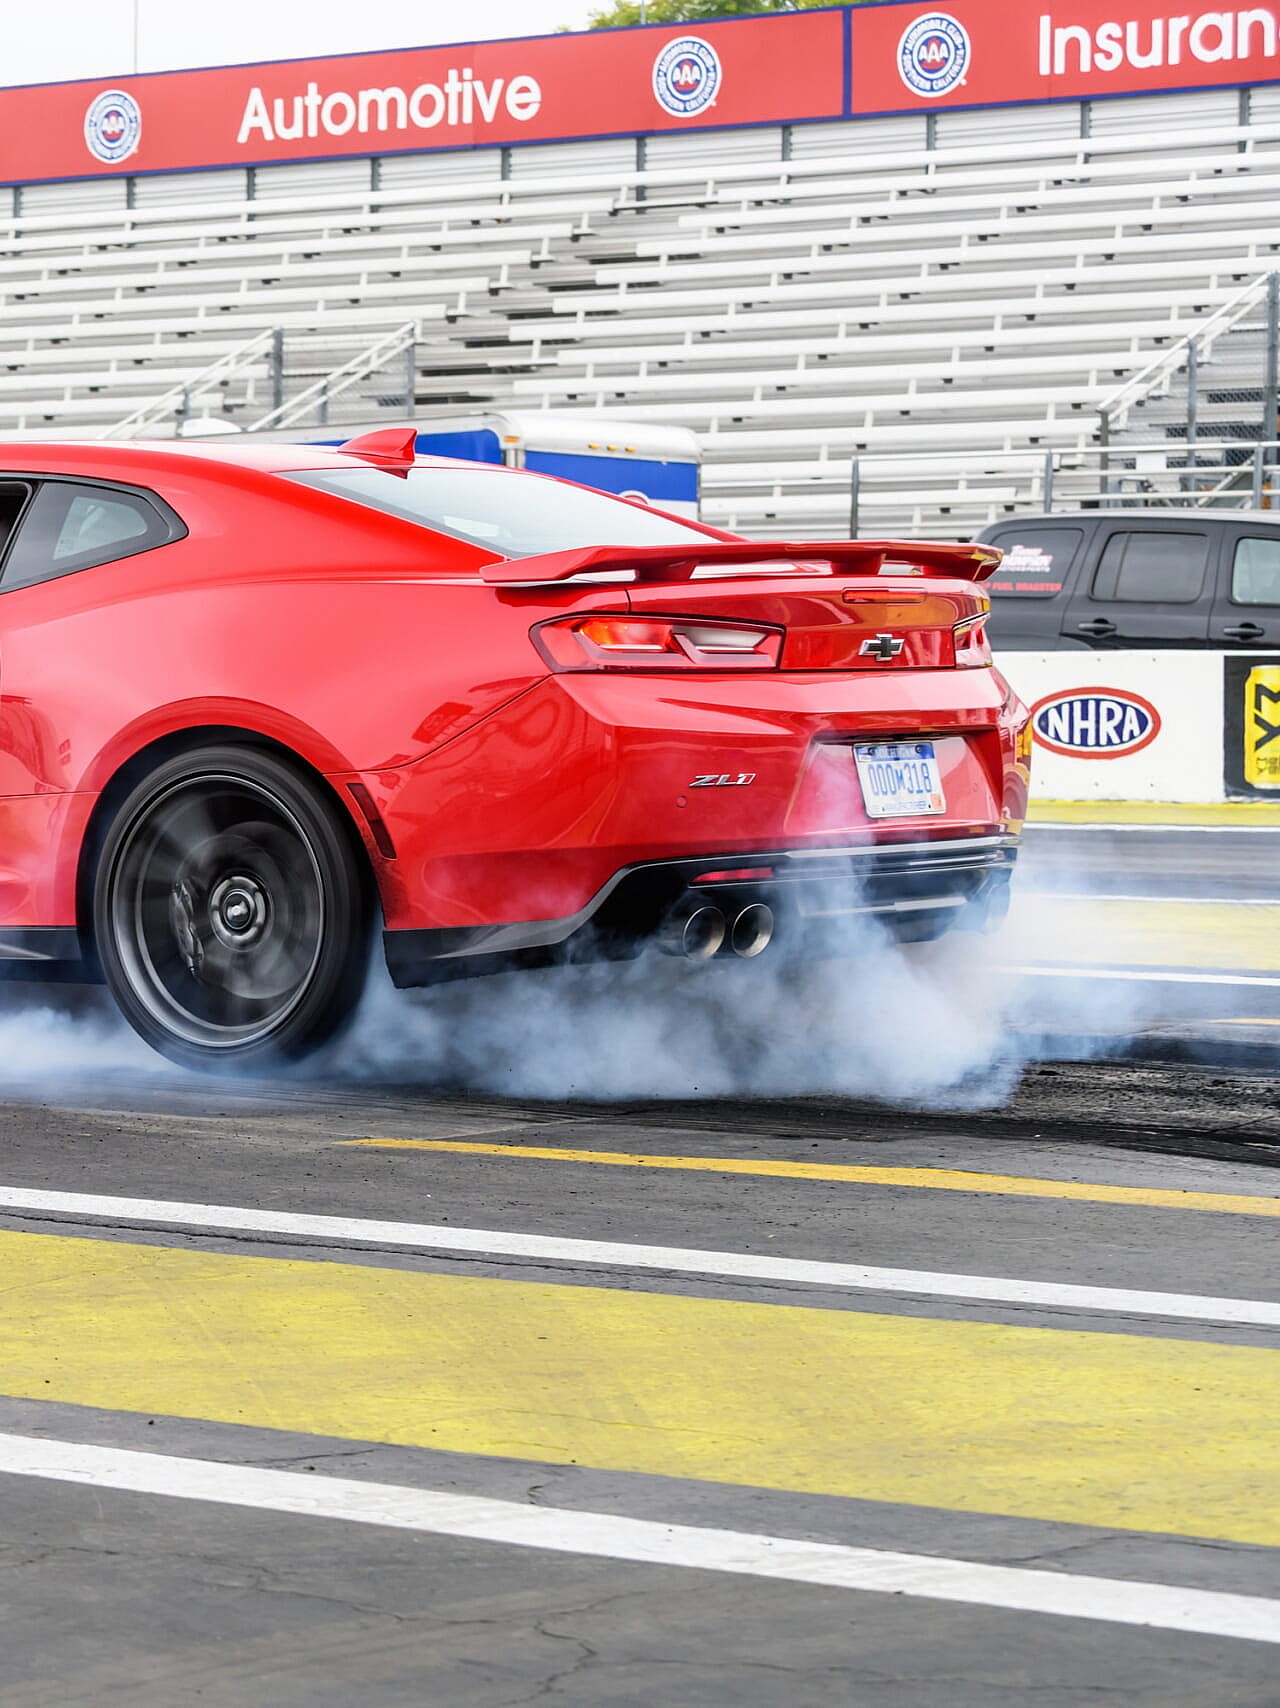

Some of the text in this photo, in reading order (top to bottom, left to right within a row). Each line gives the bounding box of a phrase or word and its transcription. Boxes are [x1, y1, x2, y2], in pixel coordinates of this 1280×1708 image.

[919, 42, 949, 63] AAA
[1039, 8, 1280, 75] Insuran
[673, 64, 701, 86] AAA
[236, 68, 542, 143] Automotive
[1047, 699, 1141, 746] NHRA
[689, 773, 756, 787] ZL1
